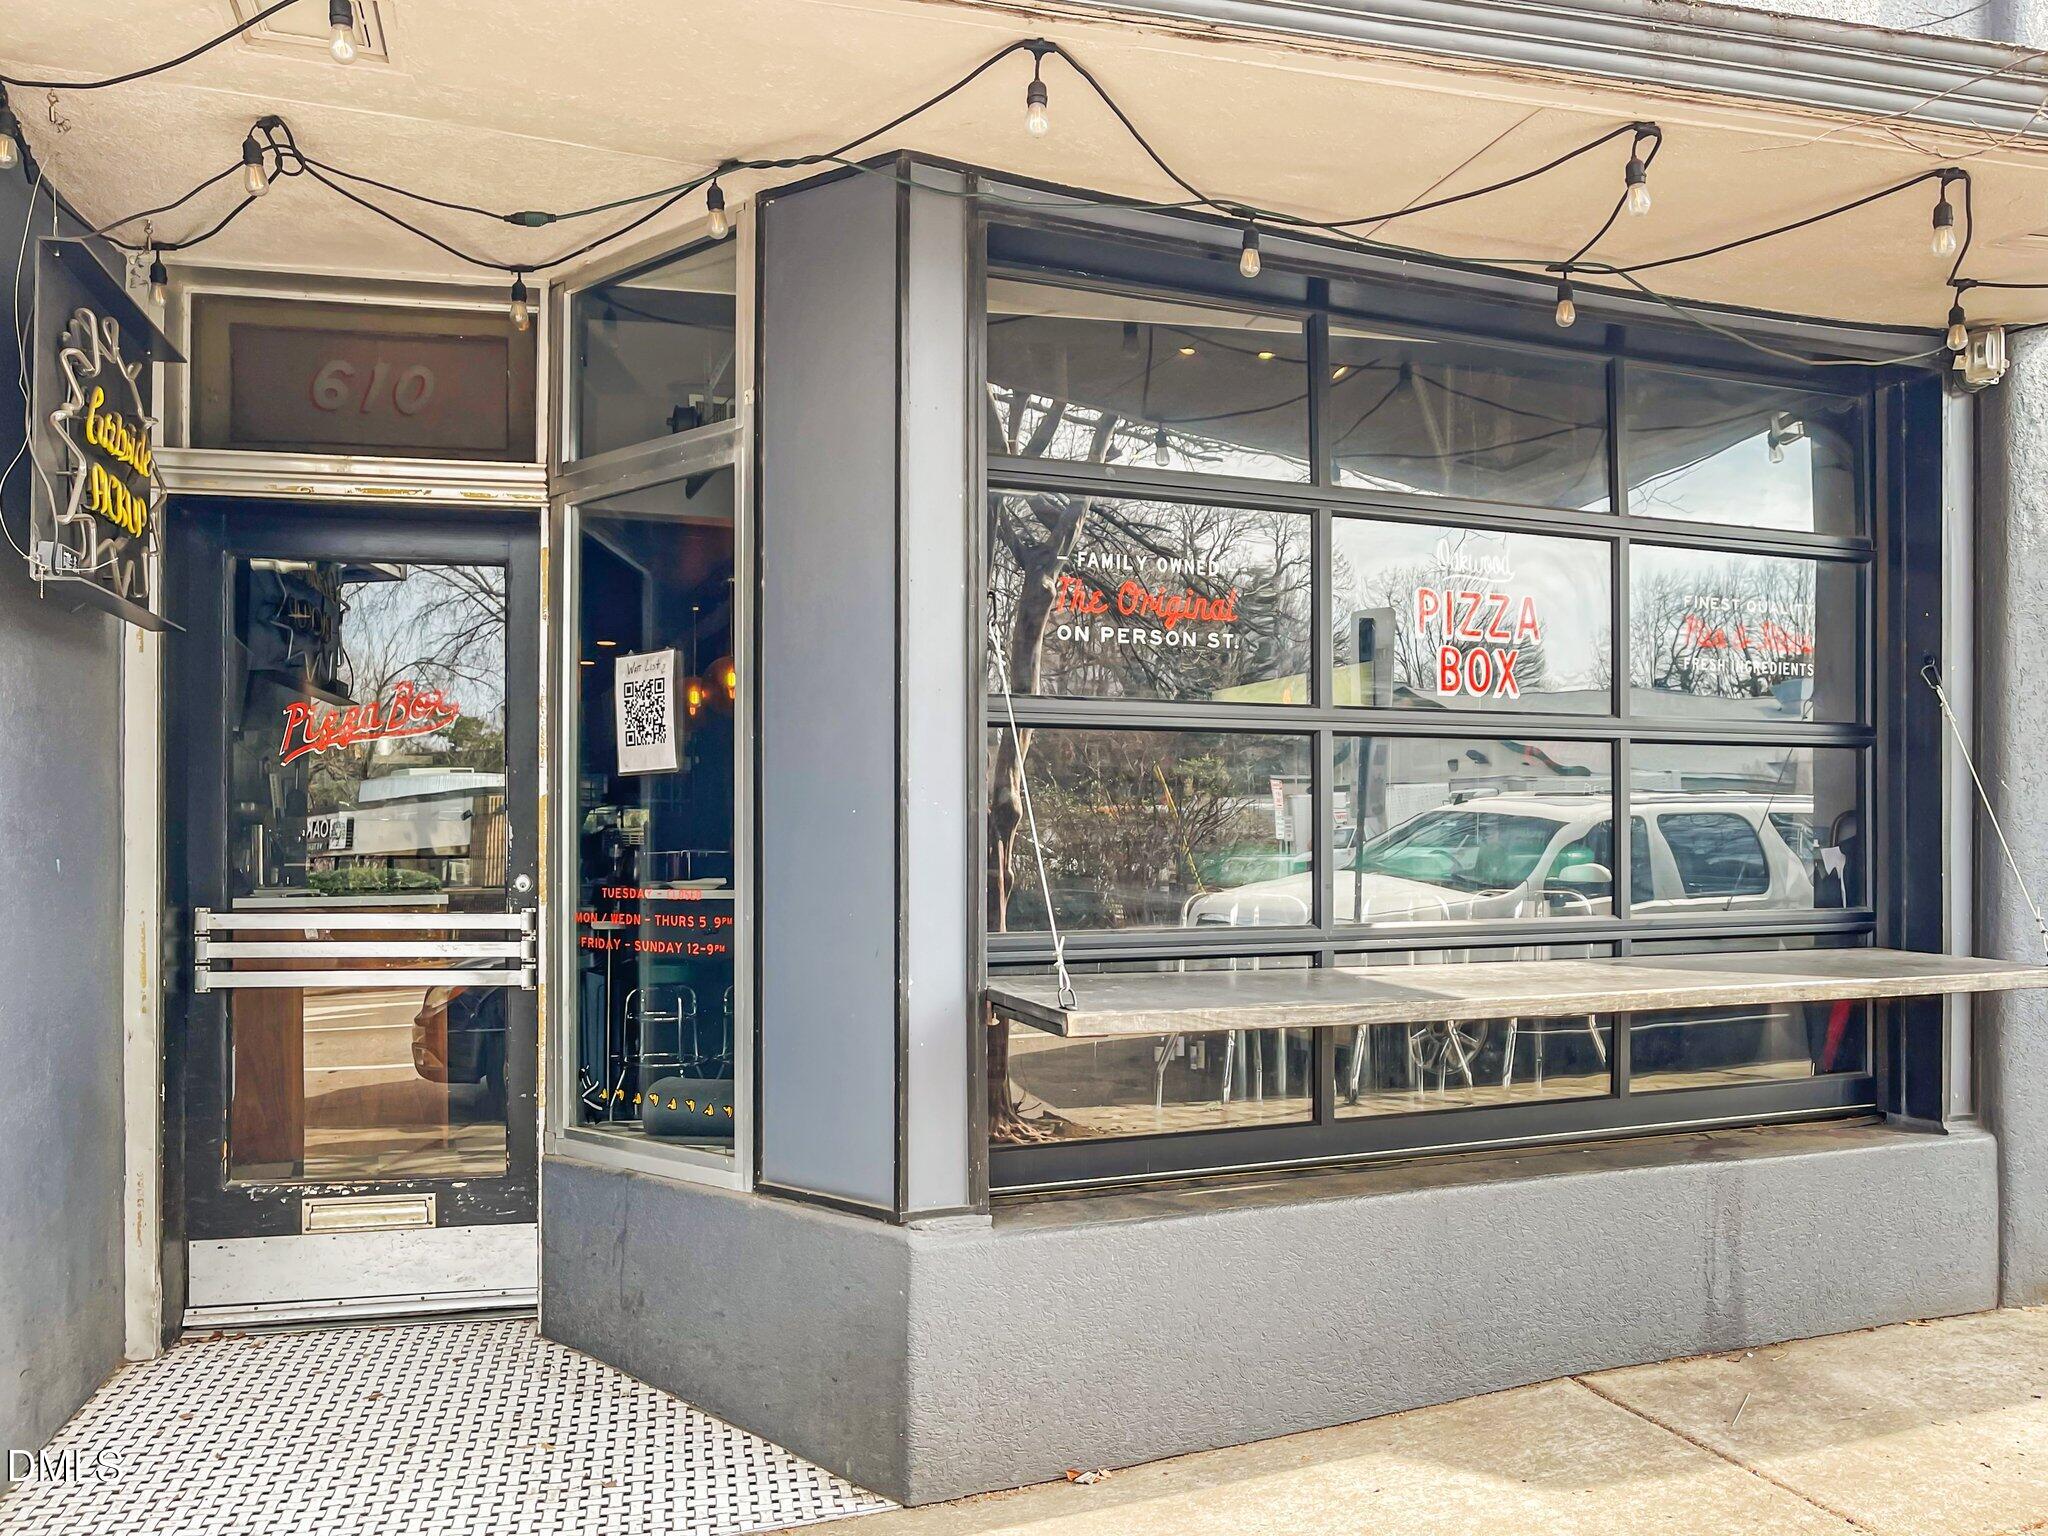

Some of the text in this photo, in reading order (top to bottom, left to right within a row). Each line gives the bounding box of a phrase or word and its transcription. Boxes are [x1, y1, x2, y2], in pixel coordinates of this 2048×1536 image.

[310, 360, 434, 416] 610
[1077, 552, 1220, 576] FAMILY OWNED
[1056, 576, 1239, 630] The Original
[1684, 595, 1740, 612] FINEST
[1414, 587, 1541, 645] PIZZA
[1056, 625, 1240, 650] ON PERSON ST.
[1437, 645, 1521, 700] BOX
[1684, 657, 1815, 677] FRESH INGREDIENTS
[280, 680, 460, 757] Pizza Box
[601, 887, 653, 899] TUESDAY
[654, 914, 695, 927] THURS
[580, 936, 621, 950] FRIDAY
[634, 940, 683, 954] SUNDAY
